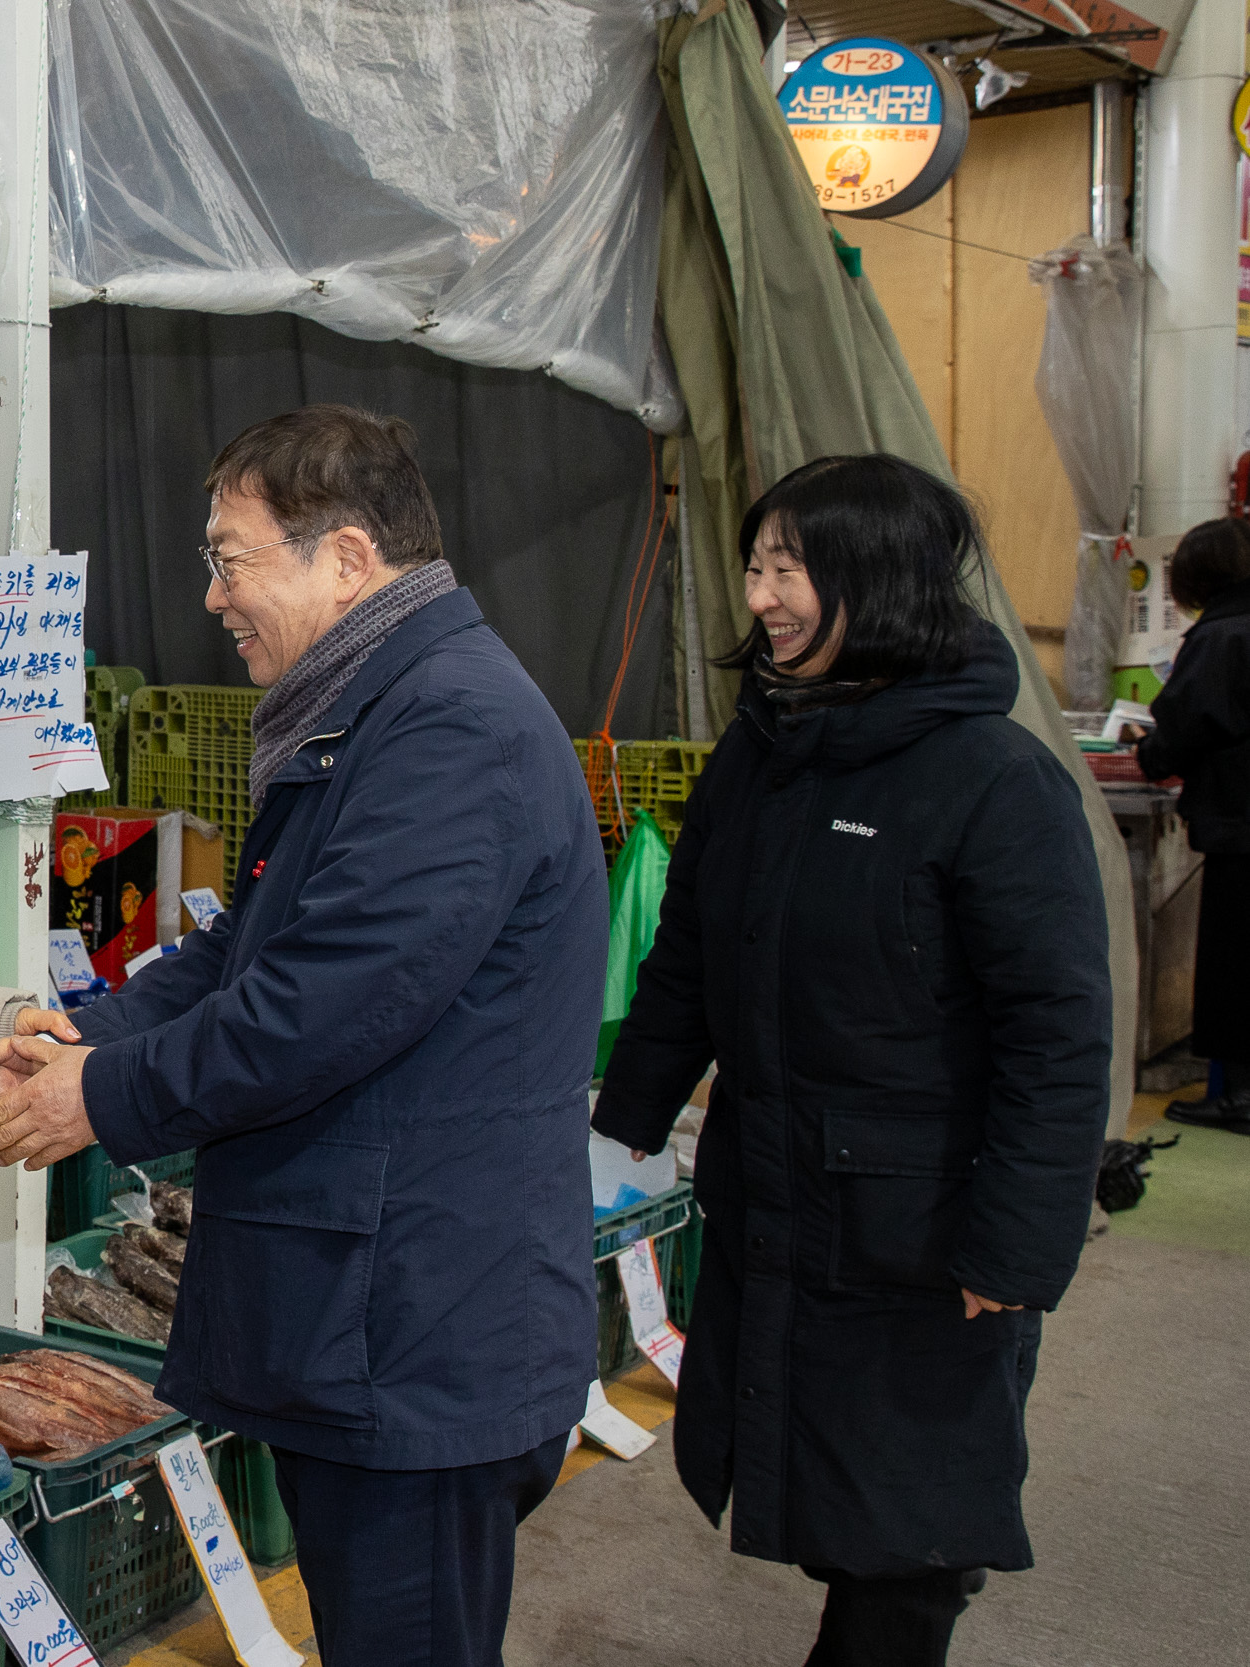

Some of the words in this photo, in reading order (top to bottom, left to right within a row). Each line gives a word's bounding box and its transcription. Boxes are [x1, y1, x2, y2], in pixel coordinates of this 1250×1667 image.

[832, 52, 895, 71] 가-23
[786, 84, 932, 122] 소문난순대국집
[831, 819, 876, 837] Dickies
